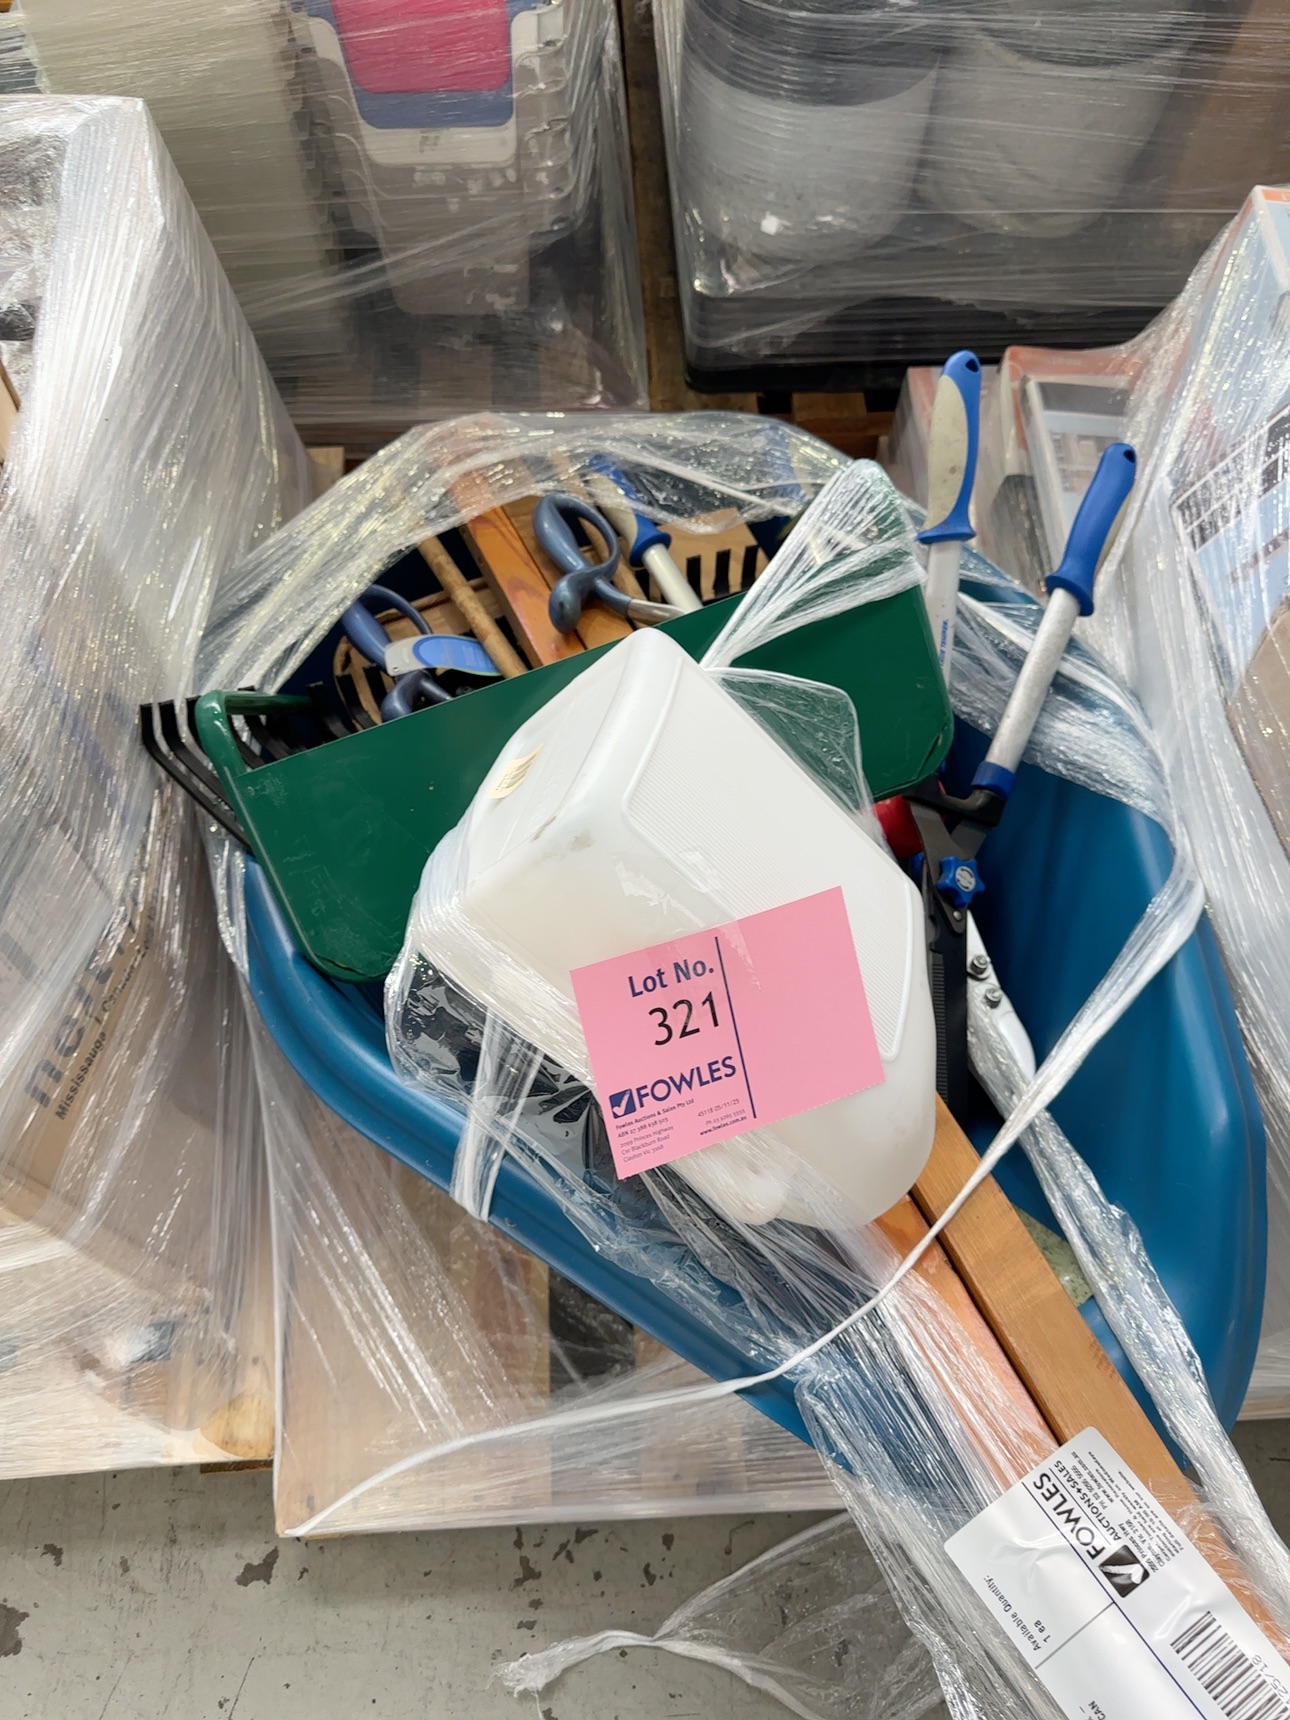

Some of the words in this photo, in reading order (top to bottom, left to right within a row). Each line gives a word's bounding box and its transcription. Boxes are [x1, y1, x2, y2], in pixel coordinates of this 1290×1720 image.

[628, 969, 668, 997] Lot
[673, 960, 714, 983] No.
[648, 991, 719, 1045] 321
[636, 1056, 736, 1108] FOWLES
[615, 1120, 633, 1130] Fowles
[634, 1111, 656, 1123] Auctions
[661, 1104, 676, 1113] Sales
[676, 1101, 685, 1109] Pty
[699, 1115, 746, 1135] www.fowles.com.au
[630, 1138, 656, 1151] Blackburn
[656, 1133, 670, 1142] Road
[633, 1132, 652, 1142] Princes
[652, 1124, 673, 1136] Highway
[623, 1151, 642, 1163] Clayton
[1054, 1460, 1121, 1541] AUCTIONS+SALES
[1098, 1499, 1108, 1509] PH
[1033, 1472, 1106, 1559] FOWLES
[1117, 1521, 1131, 1536] Hwy
[1136, 1533, 1146, 1544] Vic
[983, 1575, 1012, 1612] Quantity:
[1010, 1612, 1042, 1651] Available
[1033, 1619, 1046, 1633] ea
[1043, 1634, 1052, 1643] 1
[1252, 1655, 1290, 1706] 25/18
